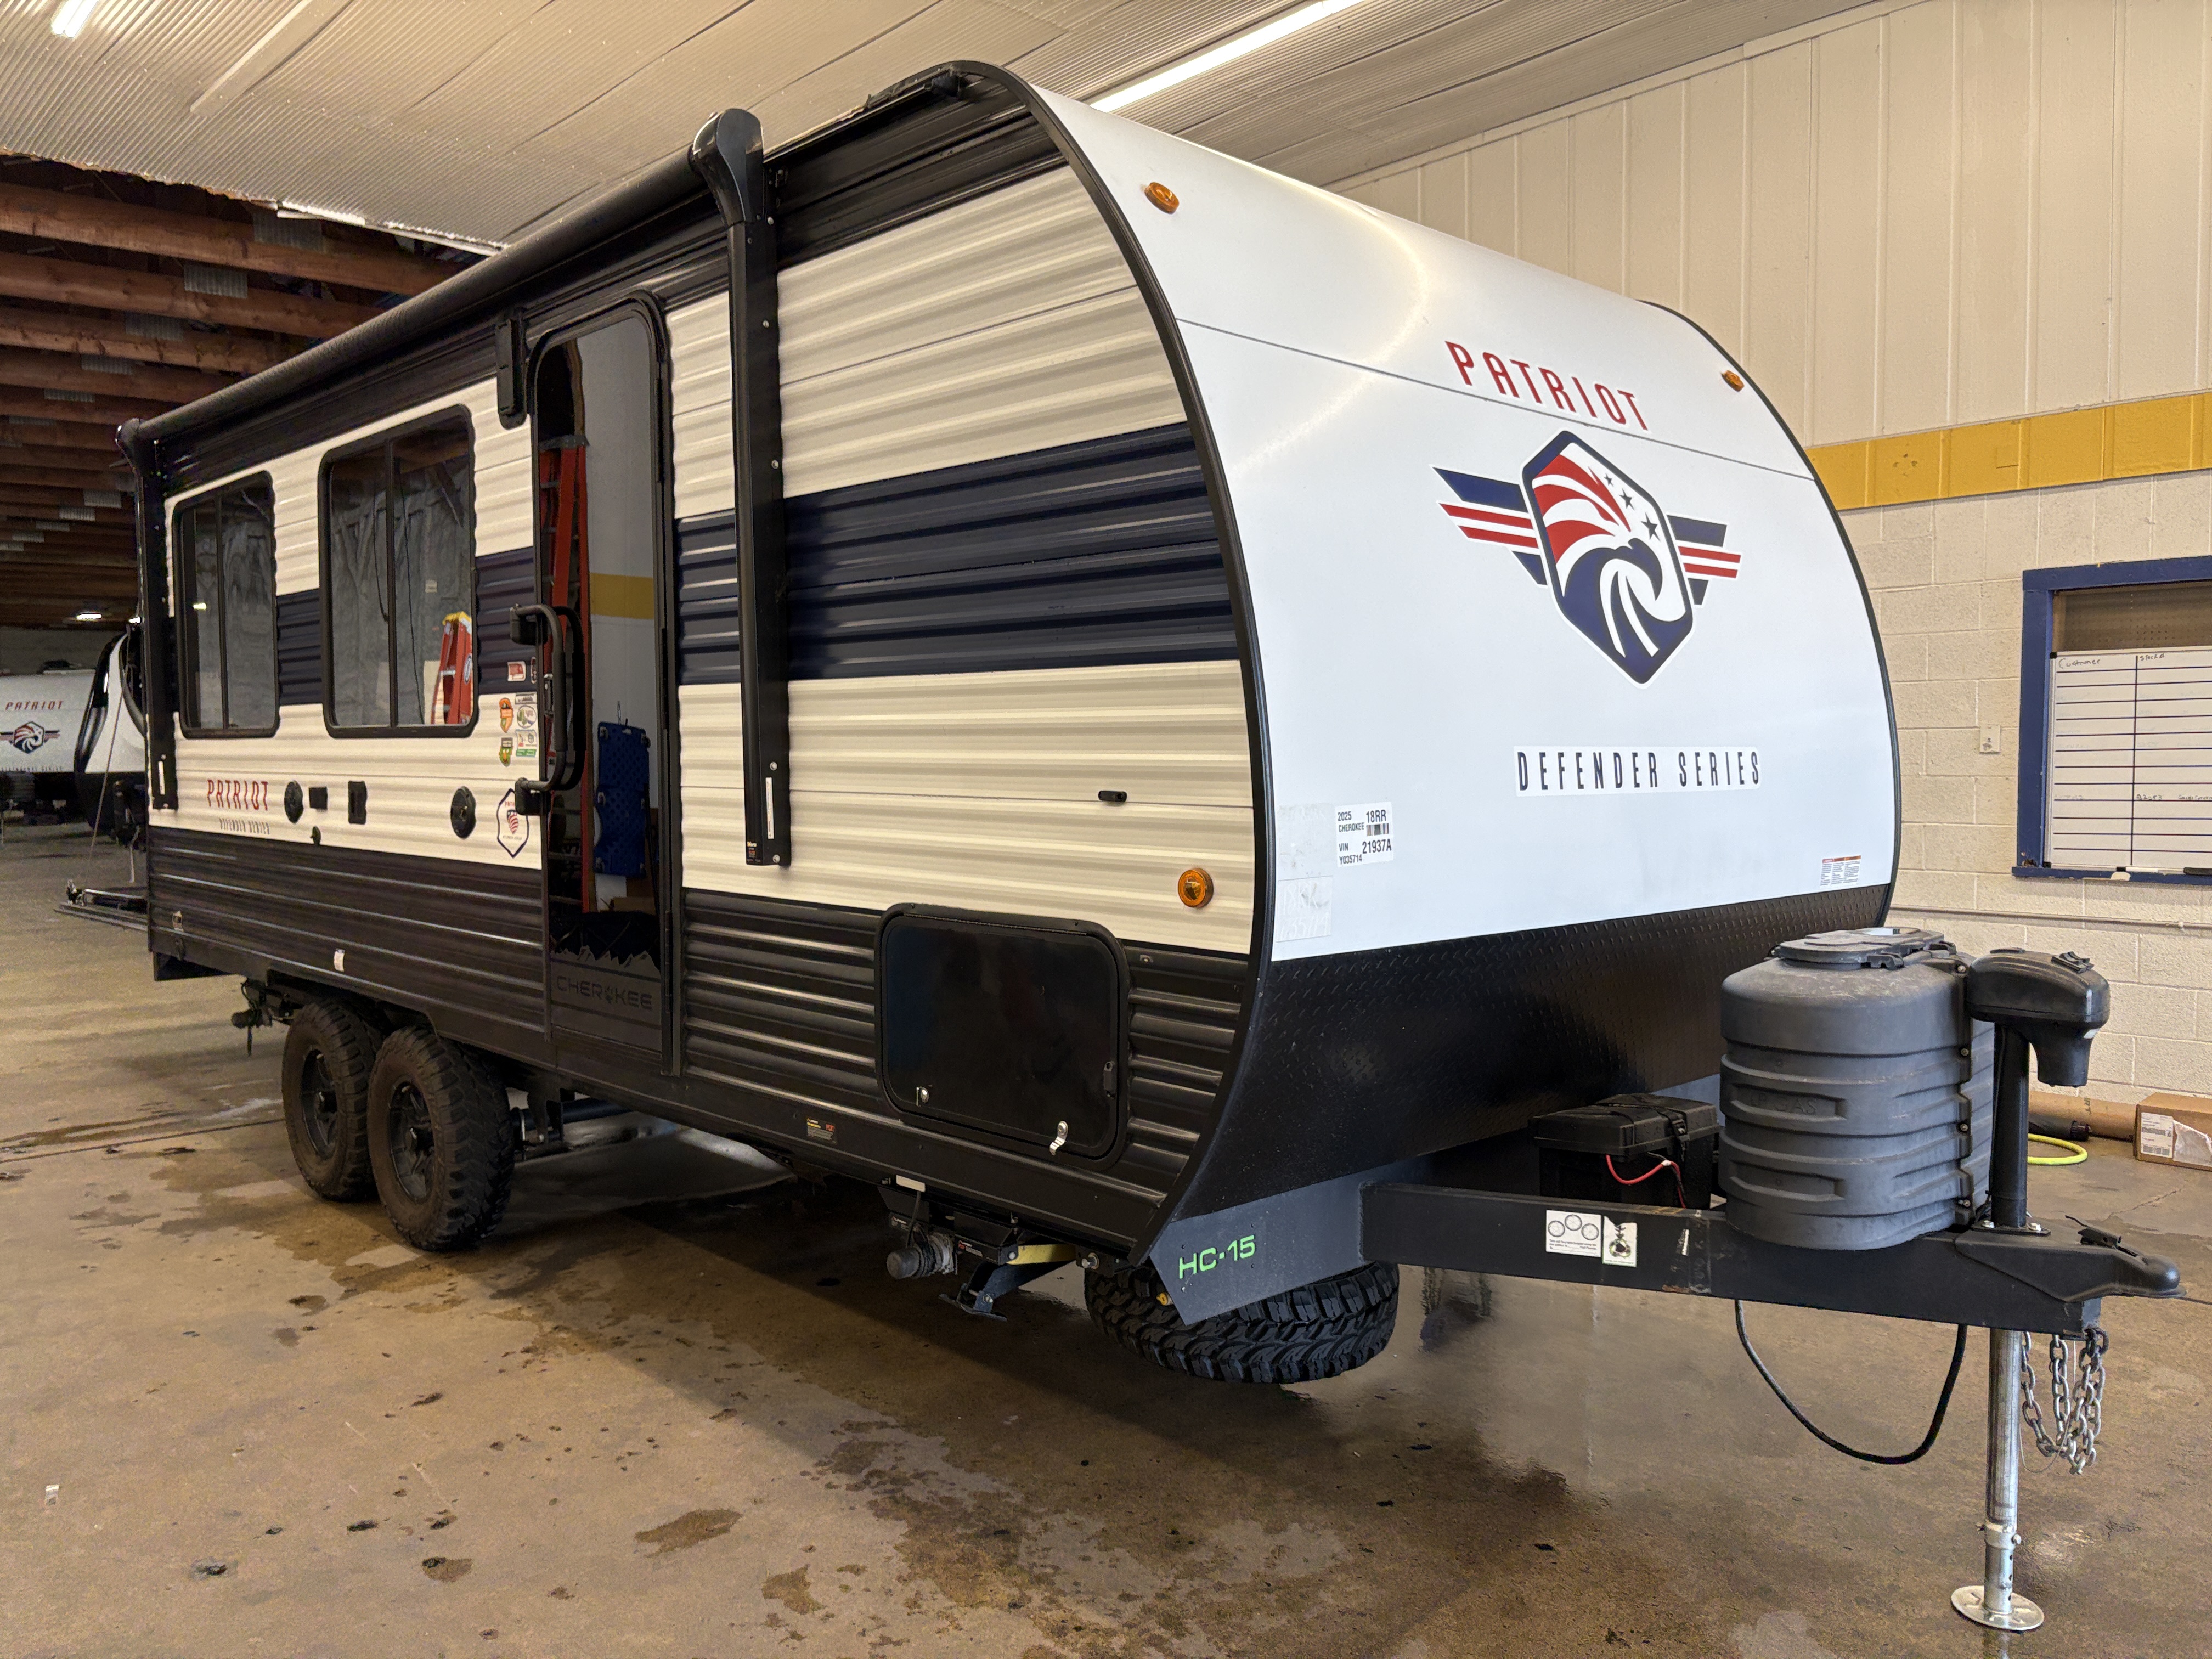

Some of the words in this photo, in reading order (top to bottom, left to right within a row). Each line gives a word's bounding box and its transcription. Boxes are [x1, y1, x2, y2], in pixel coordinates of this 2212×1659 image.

[1444, 340, 1648, 431] PATRIOT
[5, 700, 64, 711] PATRIOT
[1517, 752, 1658, 791] DEFENDER
[1678, 751, 1759, 787] SERIES
[207, 779, 269, 811] PATRIOT
[1338, 811, 1352, 822] 2025
[1365, 809, 1387, 823] 18RR
[1338, 822, 1365, 833] CHEROKEE
[1339, 843, 1349, 852] VIN
[1362, 838, 1392, 854] 21937A
